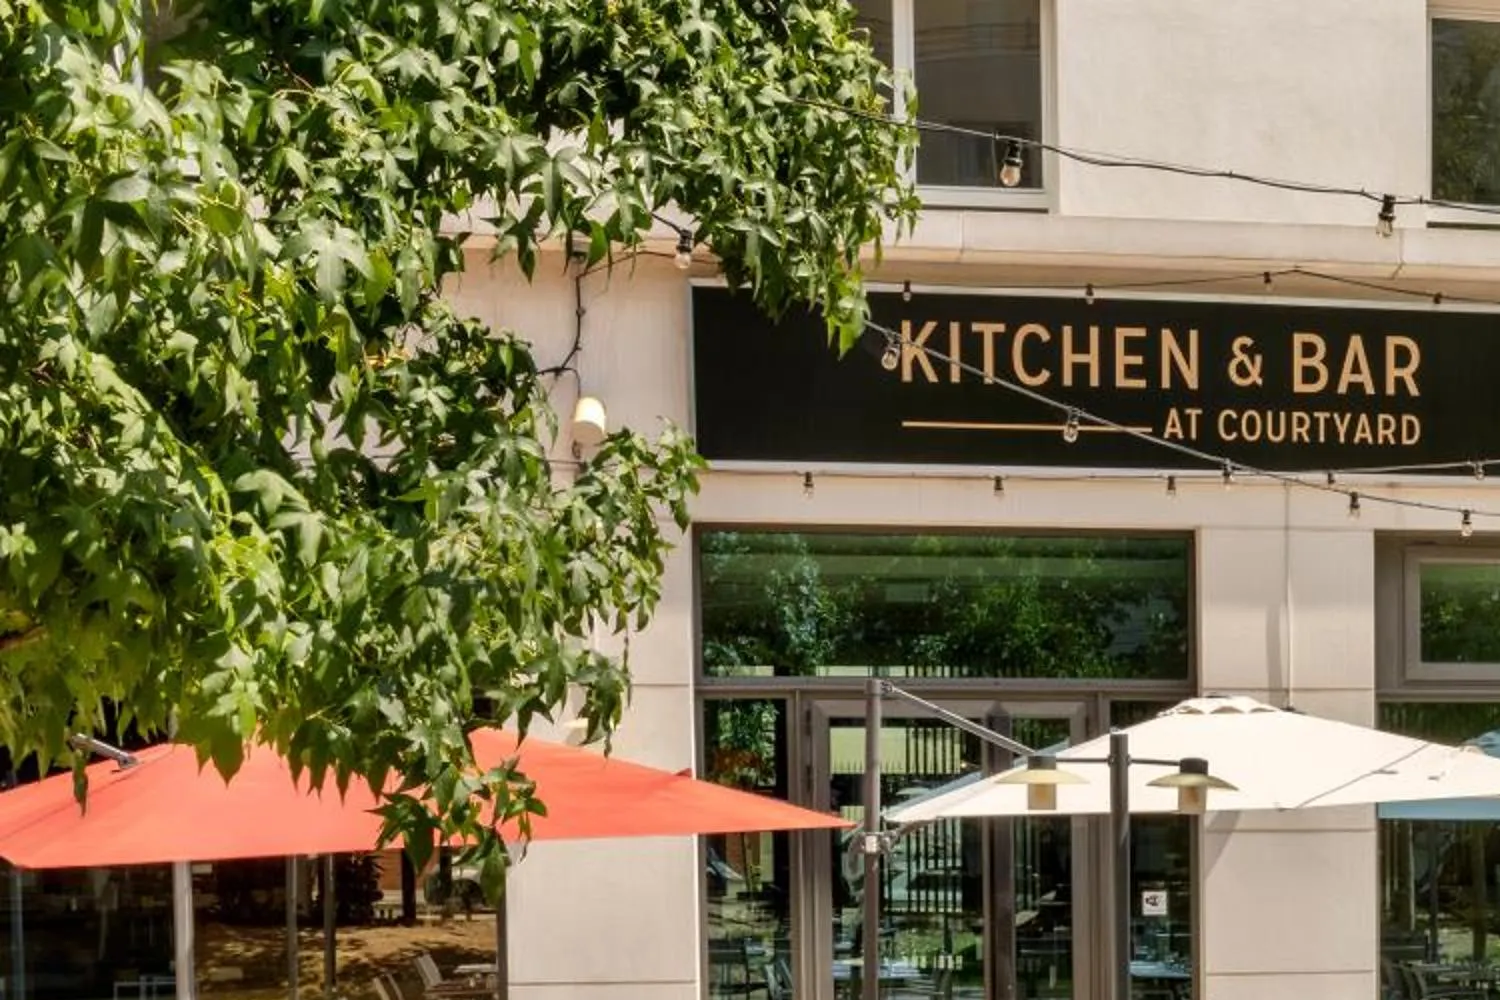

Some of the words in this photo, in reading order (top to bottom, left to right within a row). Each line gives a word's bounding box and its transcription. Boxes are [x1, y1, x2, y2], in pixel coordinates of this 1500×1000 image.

[901, 319, 1200, 390] KITCHEN
[1228, 335, 1263, 388] &
[1293, 332, 1421, 397] BAR
[1163, 408, 1202, 440] AT
[1217, 409, 1421, 446] COURTYARD
